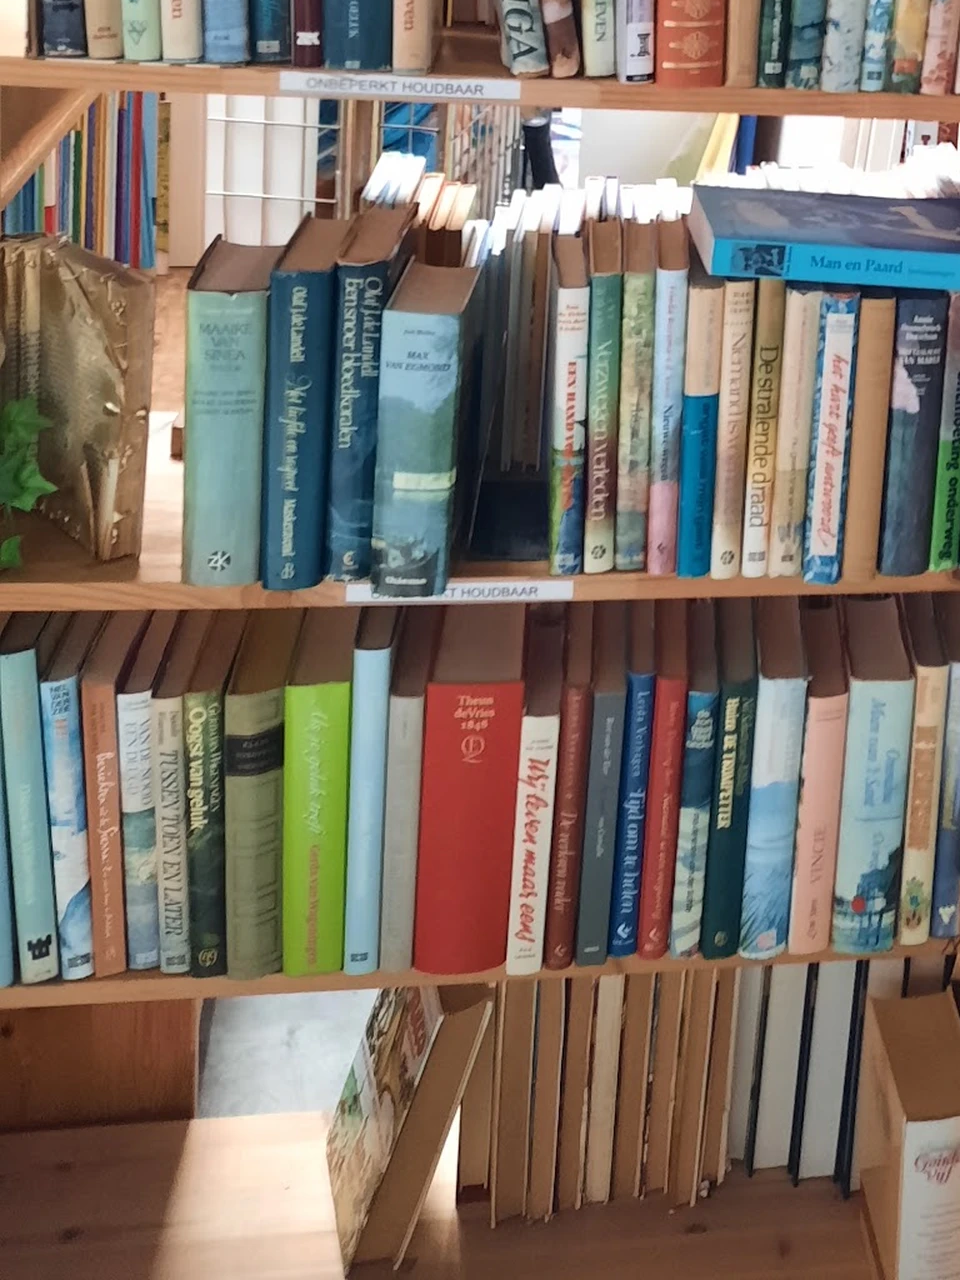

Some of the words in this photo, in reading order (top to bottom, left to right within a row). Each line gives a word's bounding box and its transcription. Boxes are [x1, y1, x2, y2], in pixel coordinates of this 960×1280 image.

[306, 76, 398, 94] ONBEPERKT
[401, 80, 485, 97] HOUDBAAR
[809, 255, 843, 270] Man
[844, 259, 862, 272] en
[344, 277, 363, 307] Een
[363, 276, 384, 306] Olaf
[342, 308, 357, 351] snoer
[758, 345, 780, 377] De
[338, 352, 362, 449] bloedkoralen
[752, 377, 777, 469] stralende
[748, 469, 775, 529] draad
[938, 476, 960, 560] onderweg
[460, 586, 539, 599] HOUDBAAR
[186, 706, 208, 758] Oogst
[157, 749, 183, 809] TUSSEN
[189, 761, 203, 788] van
[517, 757, 551, 791] Wij
[187, 789, 209, 832] geluk
[522, 794, 548, 844] leven
[623, 788, 646, 822] Tijd
[161, 814, 182, 857] TOEN
[625, 824, 639, 852] om
[162, 860, 182, 883] EN
[518, 849, 538, 900] maar
[163, 887, 184, 937] LATER
